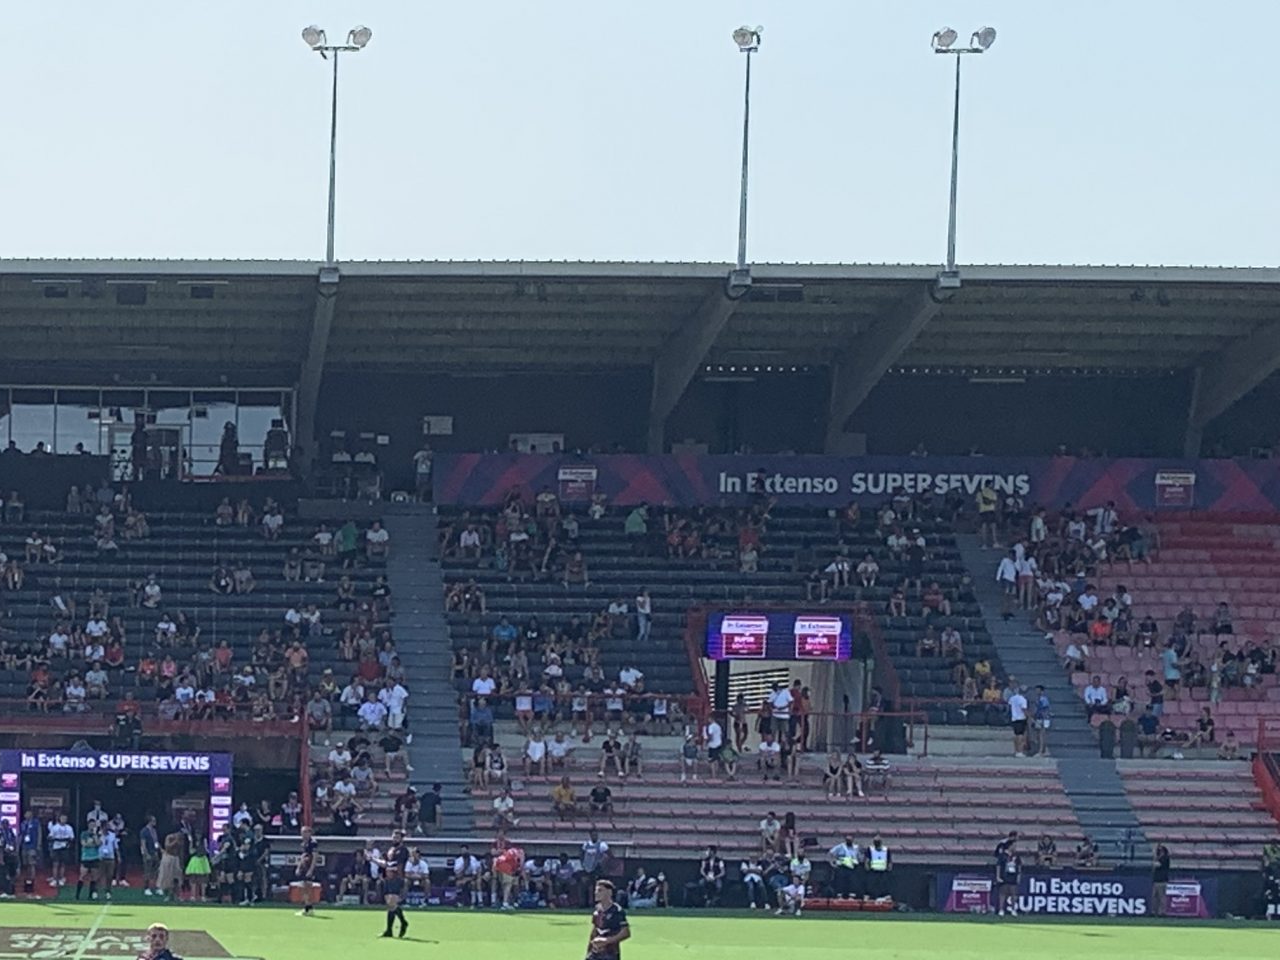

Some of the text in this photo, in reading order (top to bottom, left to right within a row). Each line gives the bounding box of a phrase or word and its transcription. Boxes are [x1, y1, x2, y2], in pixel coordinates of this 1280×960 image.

[719, 472, 741, 493] In
[21, 753, 210, 770] In Extenso SUPERSEVENS
[1029, 877, 1124, 896] In Extenso
